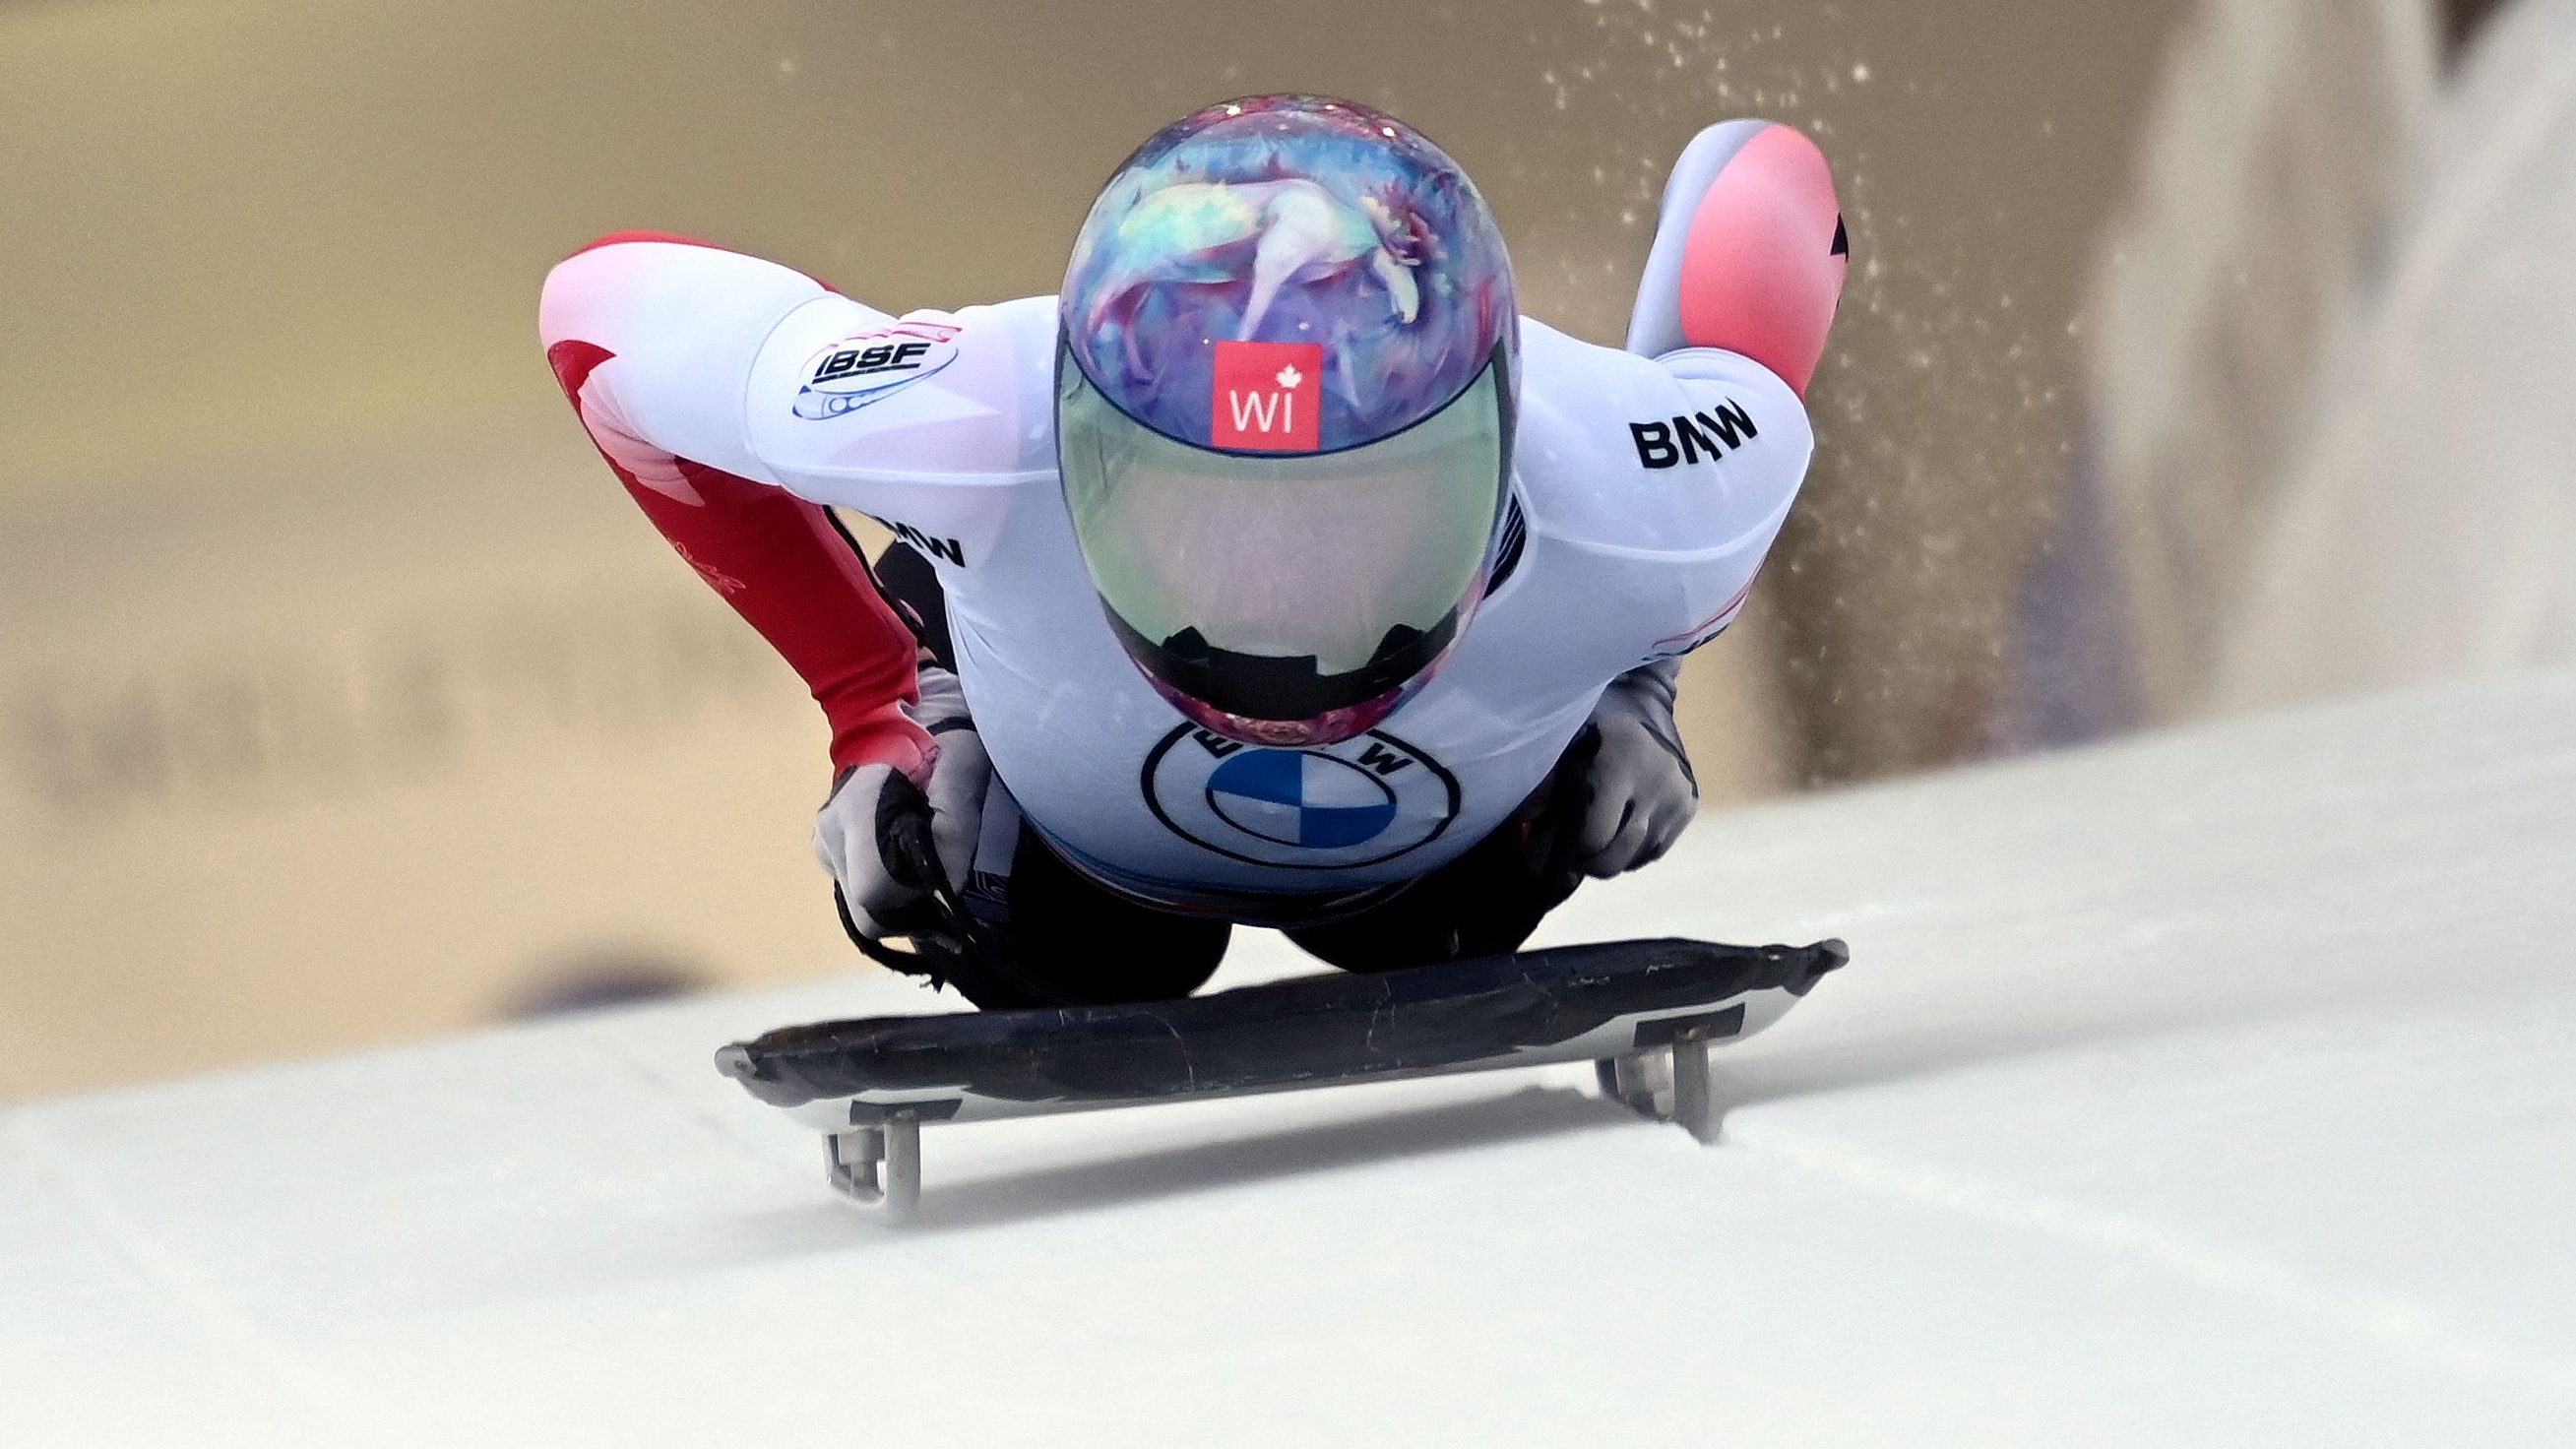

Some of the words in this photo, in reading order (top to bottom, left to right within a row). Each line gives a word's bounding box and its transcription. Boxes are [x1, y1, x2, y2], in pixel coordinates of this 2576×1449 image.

[815, 343, 931, 377] IBSF
[1629, 396, 1758, 469] BMW
[1192, 729, 1414, 776] BW
